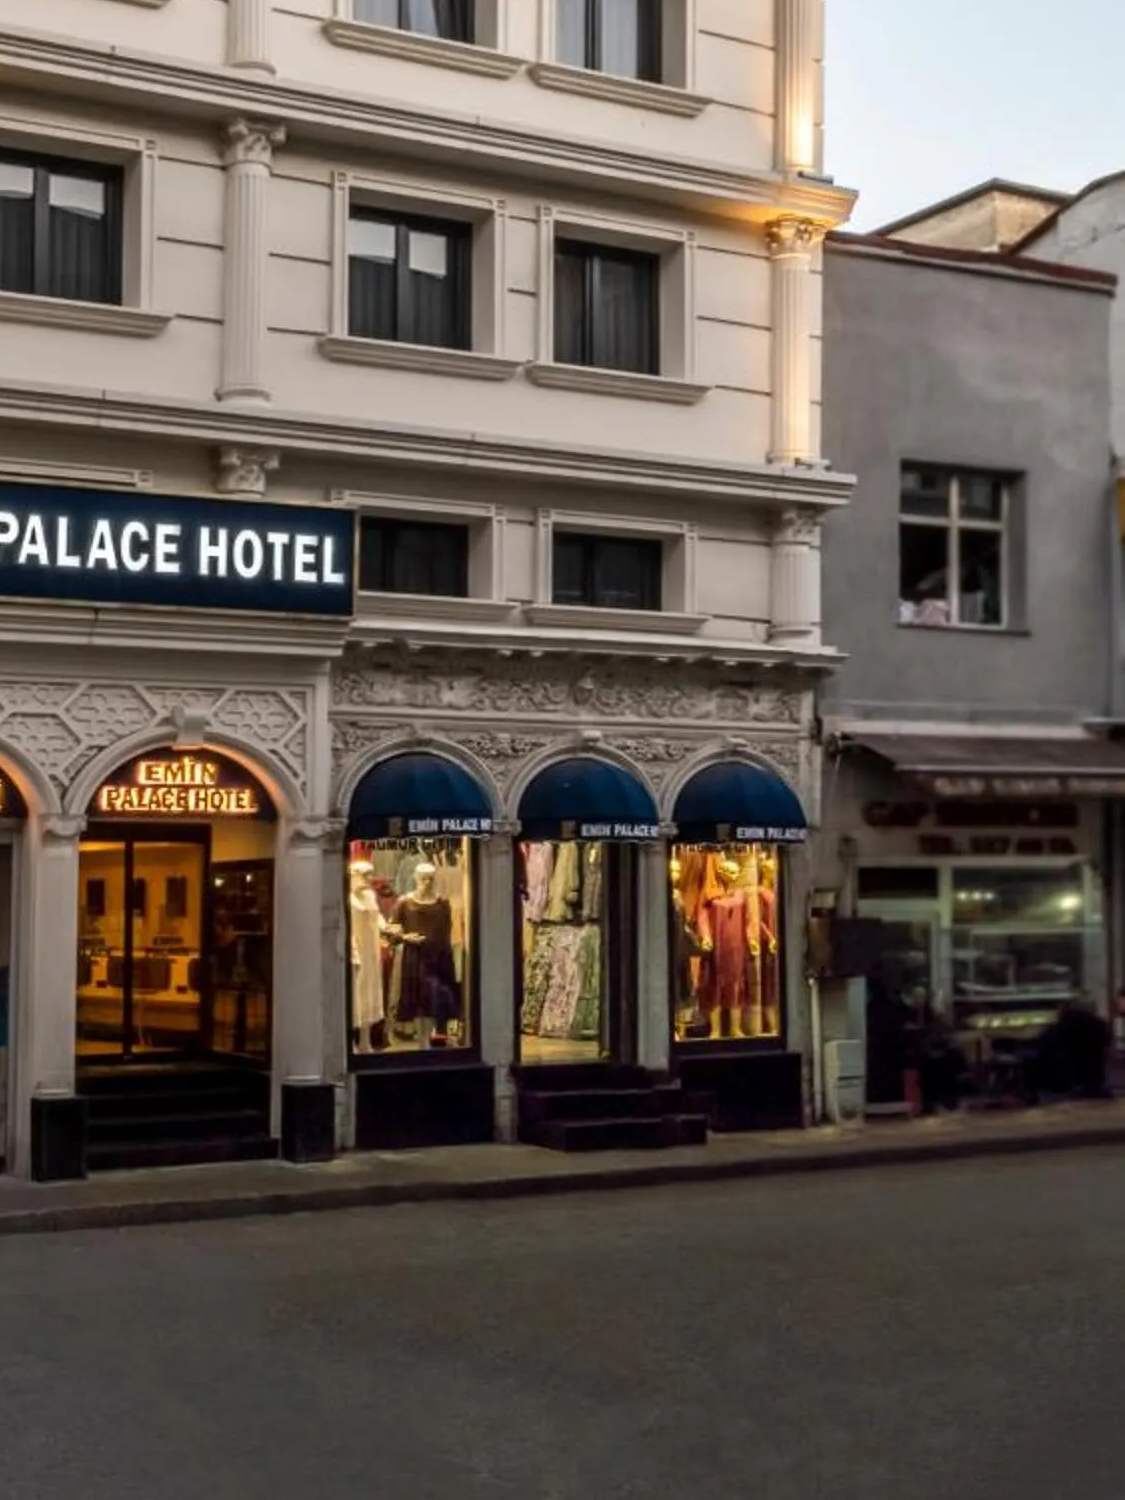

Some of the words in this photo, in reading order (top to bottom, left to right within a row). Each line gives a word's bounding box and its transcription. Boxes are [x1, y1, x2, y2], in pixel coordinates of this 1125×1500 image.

[199, 526, 345, 584] HOTEL
[138, 756, 217, 785] EMİN
[101, 785, 184, 812] PALACE
[188, 787, 259, 813] HOTEL
